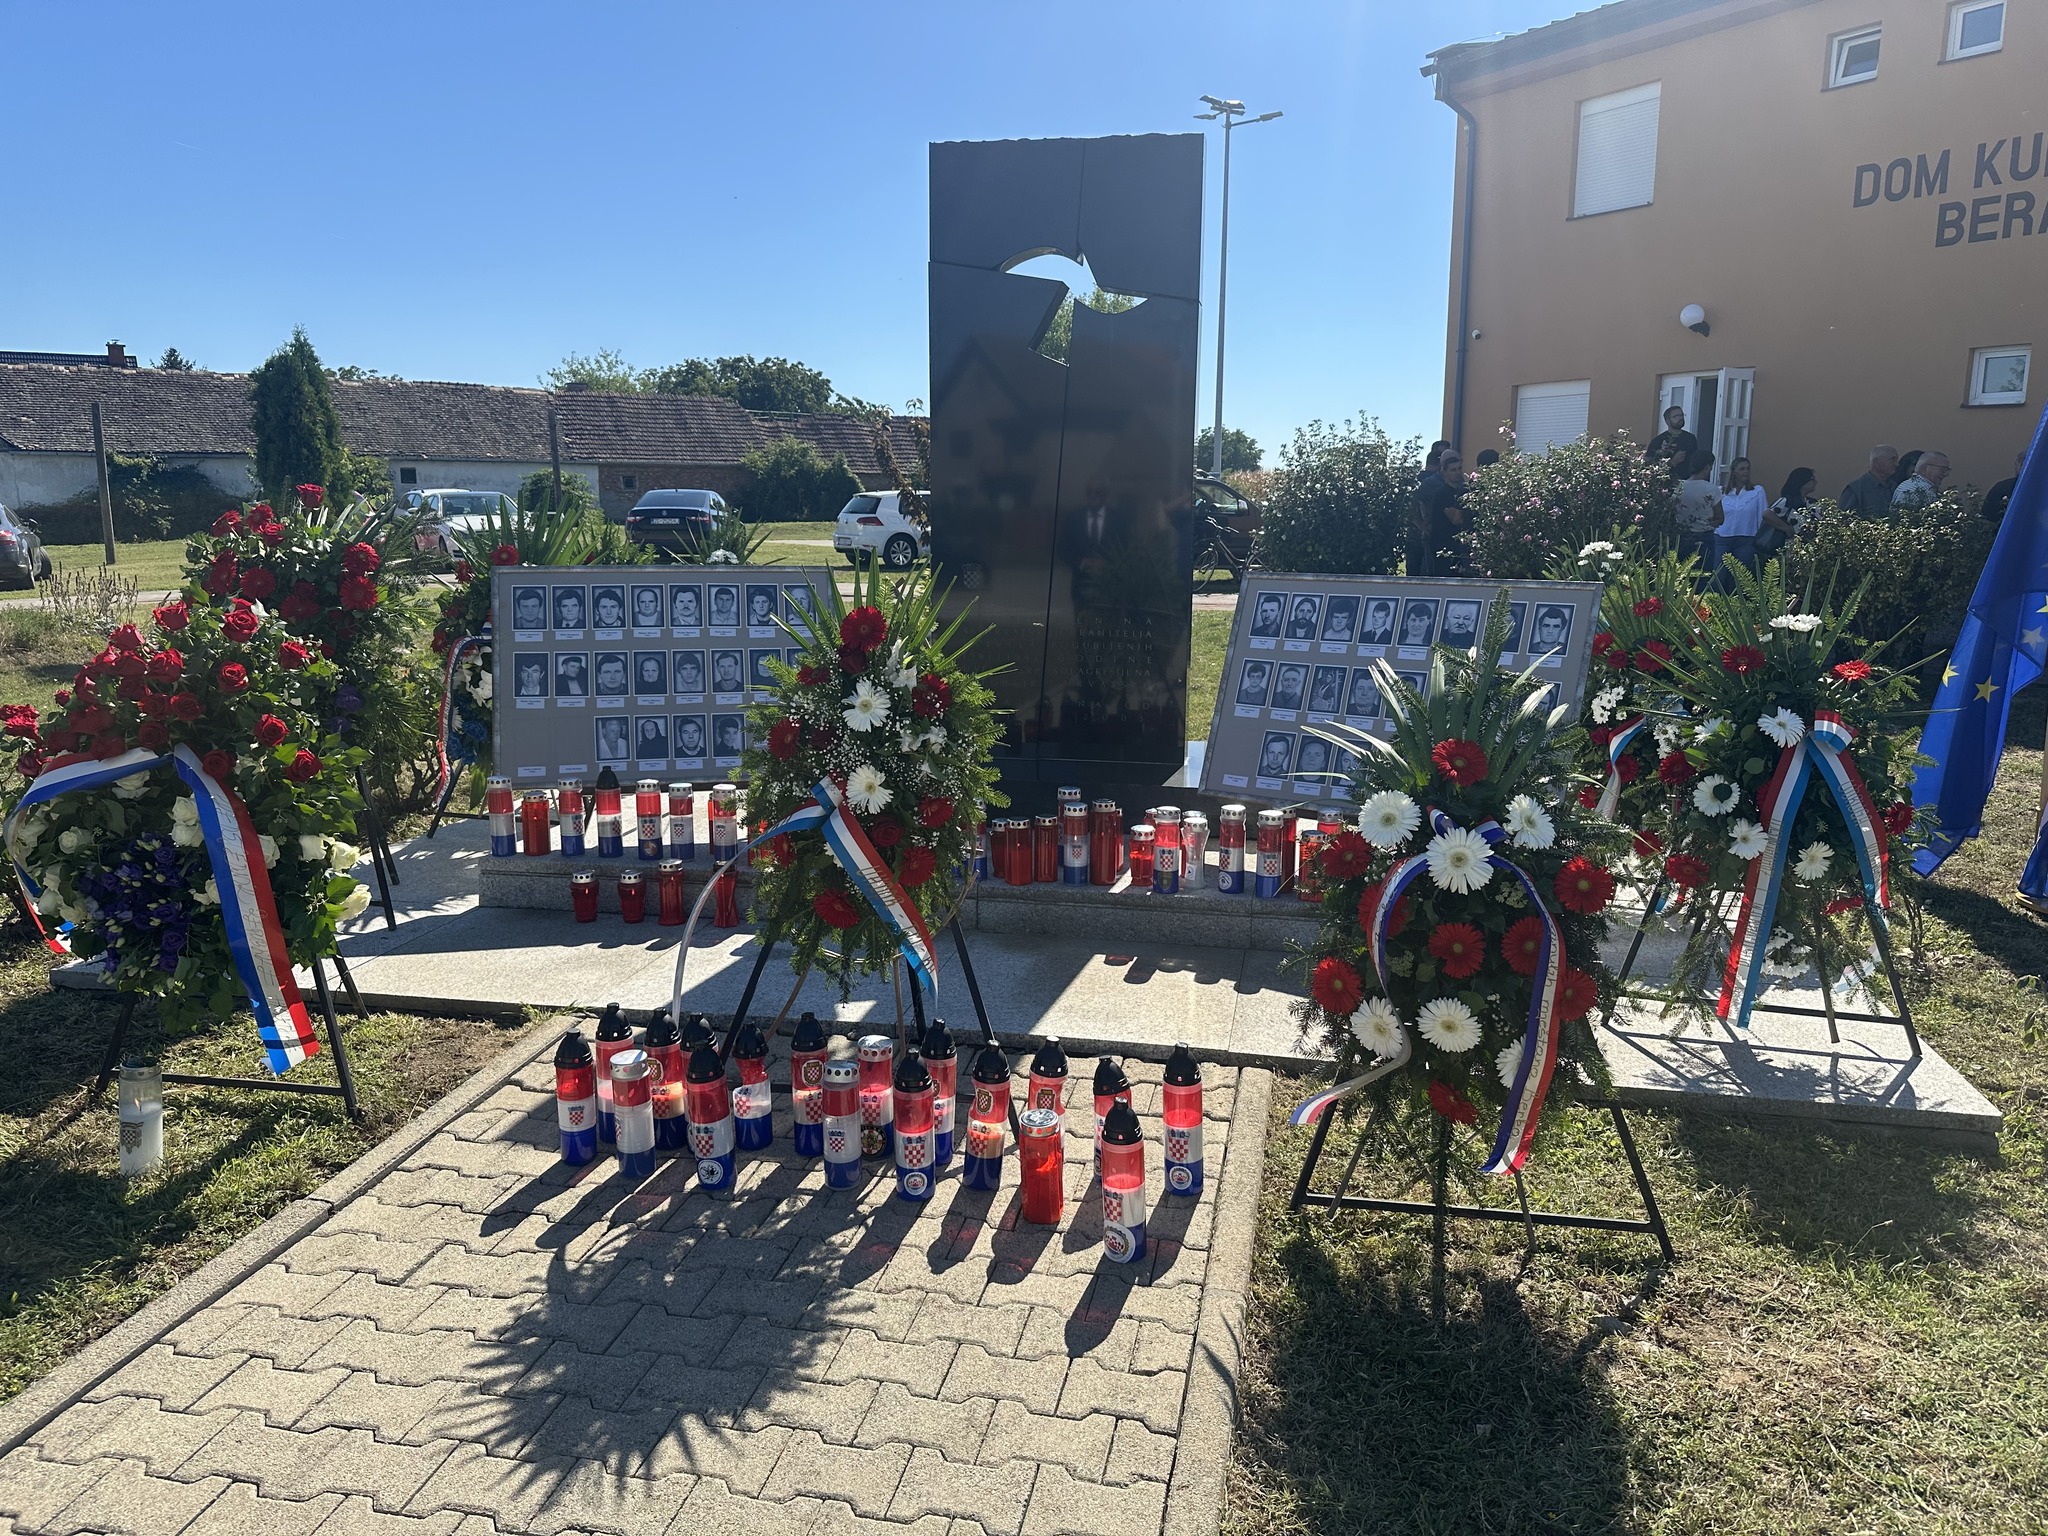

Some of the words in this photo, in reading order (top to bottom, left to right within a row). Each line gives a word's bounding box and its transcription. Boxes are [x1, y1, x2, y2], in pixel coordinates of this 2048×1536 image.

[1853, 148, 1951, 208] DOM
[1973, 130, 2048, 189] KU
[1074, 629, 1153, 639] RANITELJA
